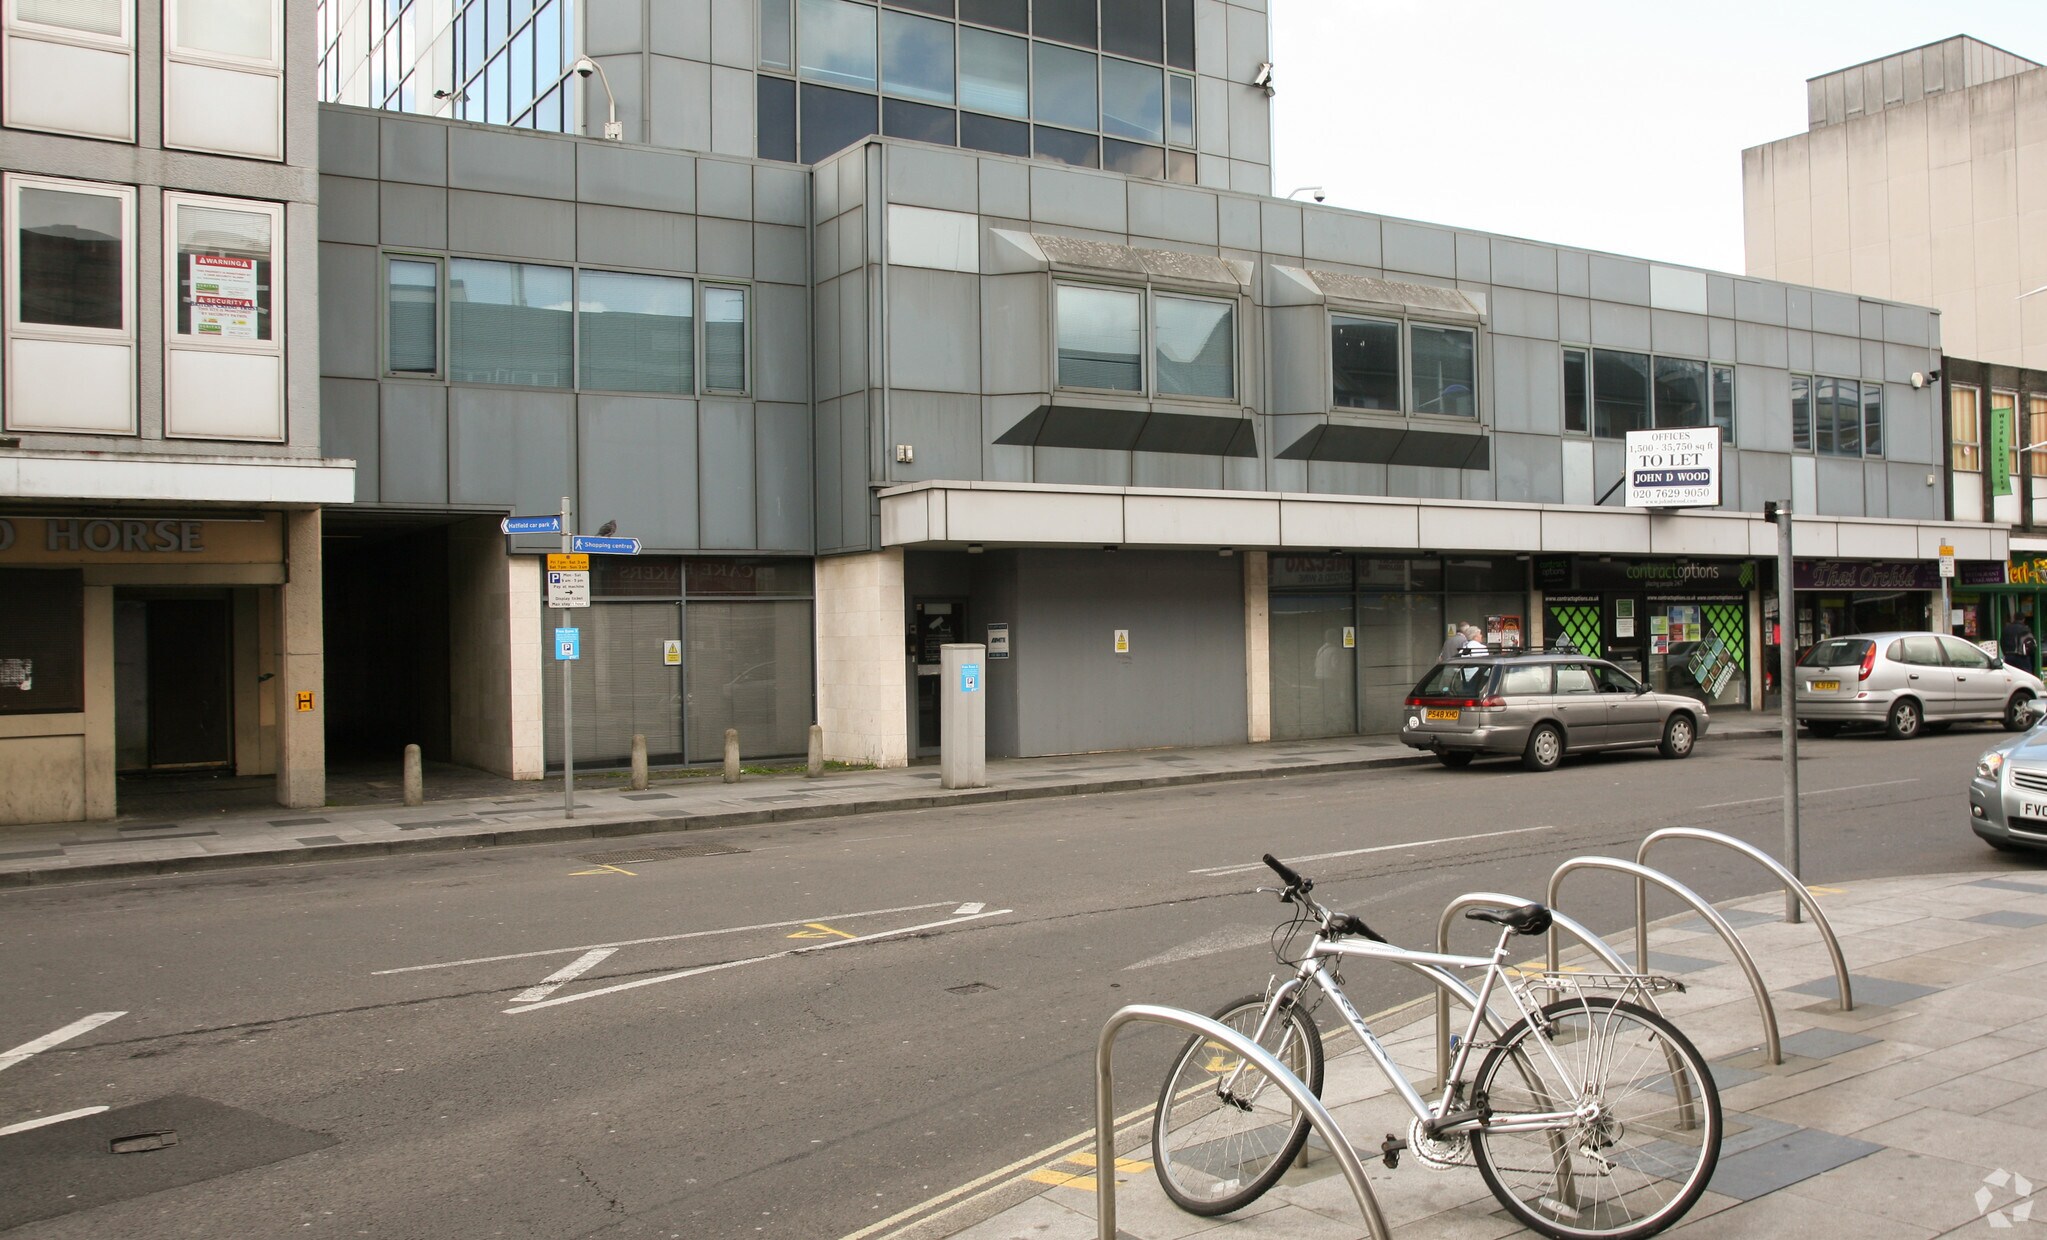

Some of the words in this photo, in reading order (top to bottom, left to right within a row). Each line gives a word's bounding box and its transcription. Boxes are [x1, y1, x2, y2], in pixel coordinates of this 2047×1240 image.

[206, 257, 242, 267] WARNING
[206, 297, 243, 306] SECURITY
[1651, 431, 1691, 442] OFFICES
[1629, 444, 1654, 453] 1,500
[1661, 442, 1693, 452] 35,750
[1707, 441, 1713, 450] ft
[1639, 454, 1663, 467] TO
[1669, 453, 1703, 466] LET
[1635, 473, 1662, 484] JOHN
[1665, 472, 1674, 482] D
[1677, 471, 1709, 481] WOOD
[1633, 489, 1652, 499] 020
[1656, 489, 1680, 498] 7629
[1684, 488, 1710, 497] 9050
[46, 518, 205, 553] HORSE
[584, 541, 611, 550] Shopping
[551, 573, 560, 583] P
[1626, 562, 1719, 583] contractoptions
[1813, 563, 1857, 587] Thai
[1859, 564, 1919, 587] Orchid
[1713, 664, 1737, 699] HOSPITALITY
[297, 692, 313, 710] H
